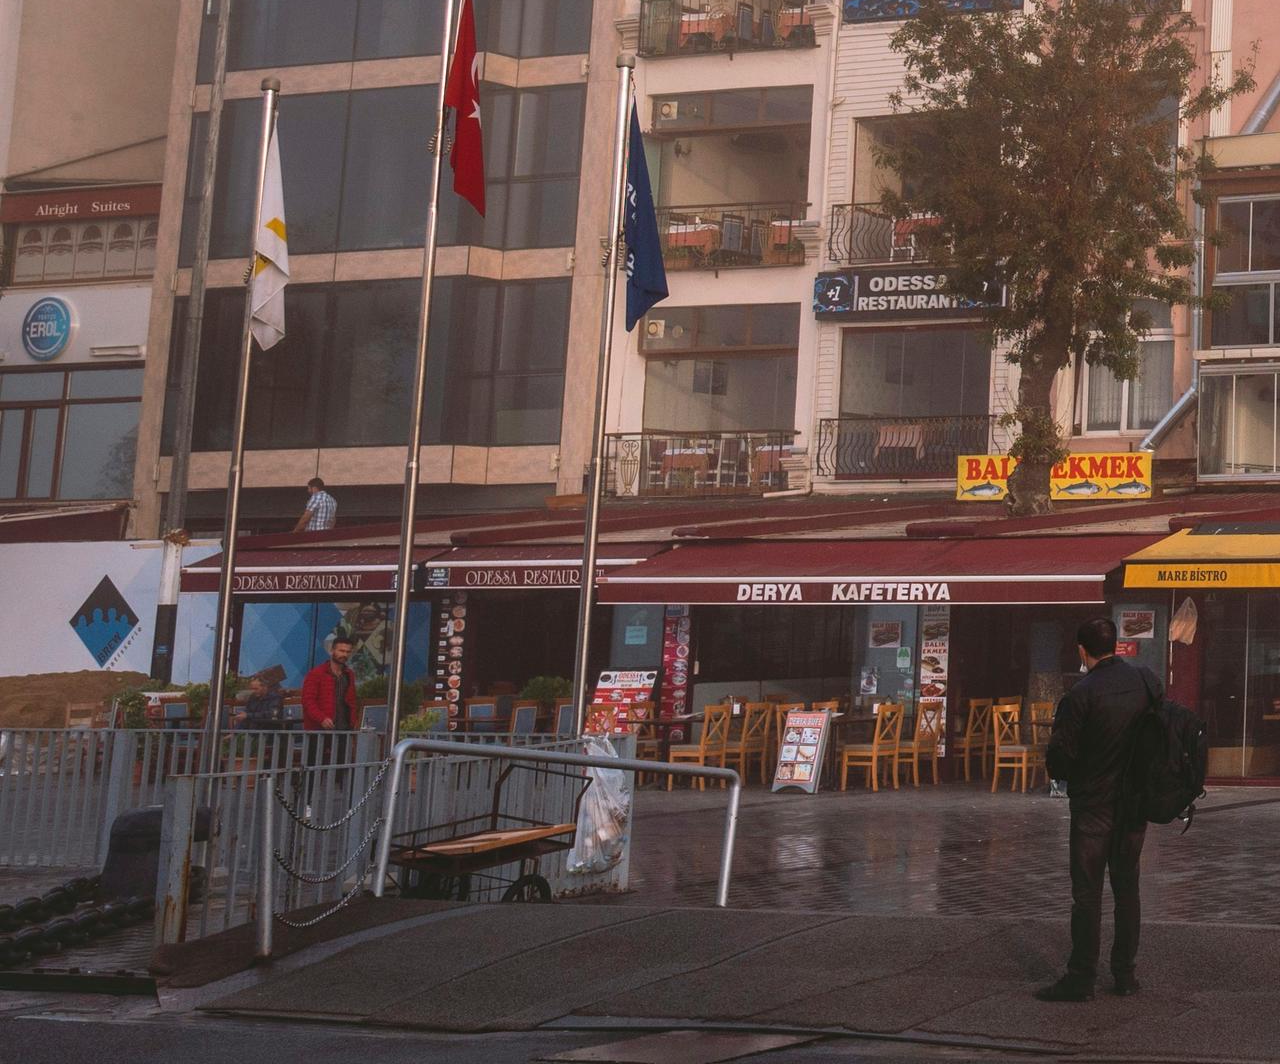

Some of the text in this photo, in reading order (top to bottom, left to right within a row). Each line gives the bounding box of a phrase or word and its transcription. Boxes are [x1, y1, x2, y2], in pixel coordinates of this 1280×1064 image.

[35, 200, 131, 218] Alright Suites
[30, 321, 62, 338] EROL
[1051, 456, 1144, 479] EKMEK
[284, 574, 362, 590] RESTAURANT
[465, 570, 517, 586] ODESSA
[1157, 567, 1228, 581] MARE BİSTRO
[736, 582, 951, 601] DERYA KAFETERYA
